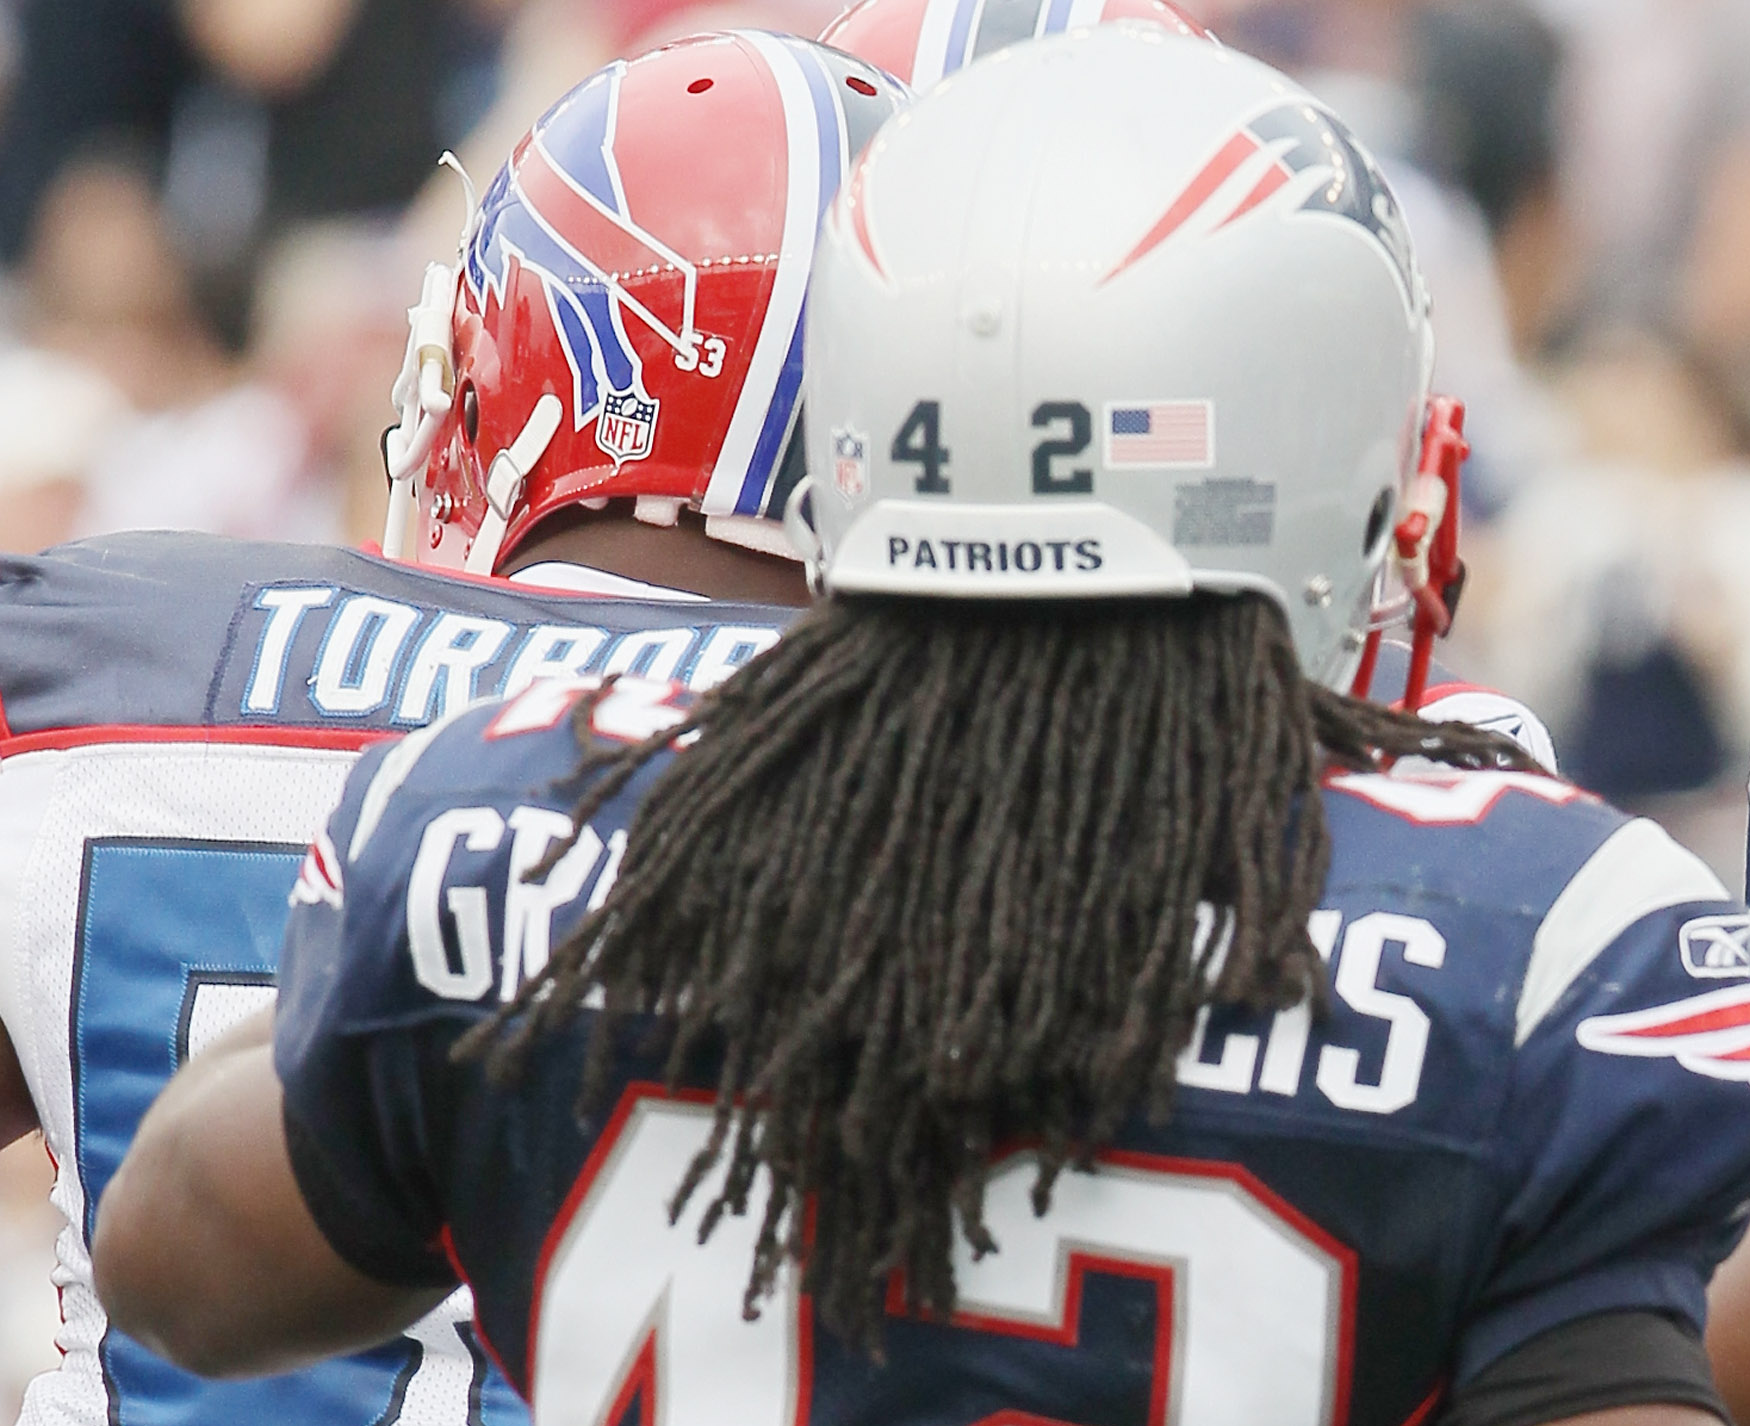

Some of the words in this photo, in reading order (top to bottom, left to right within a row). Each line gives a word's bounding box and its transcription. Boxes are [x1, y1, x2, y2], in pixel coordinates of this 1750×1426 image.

[673, 329, 728, 379] 53
[603, 416, 644, 451] NFL
[890, 400, 950, 493] 4
[1030, 400, 1094, 493] 2
[888, 536, 1104, 572] PATRIOTS
